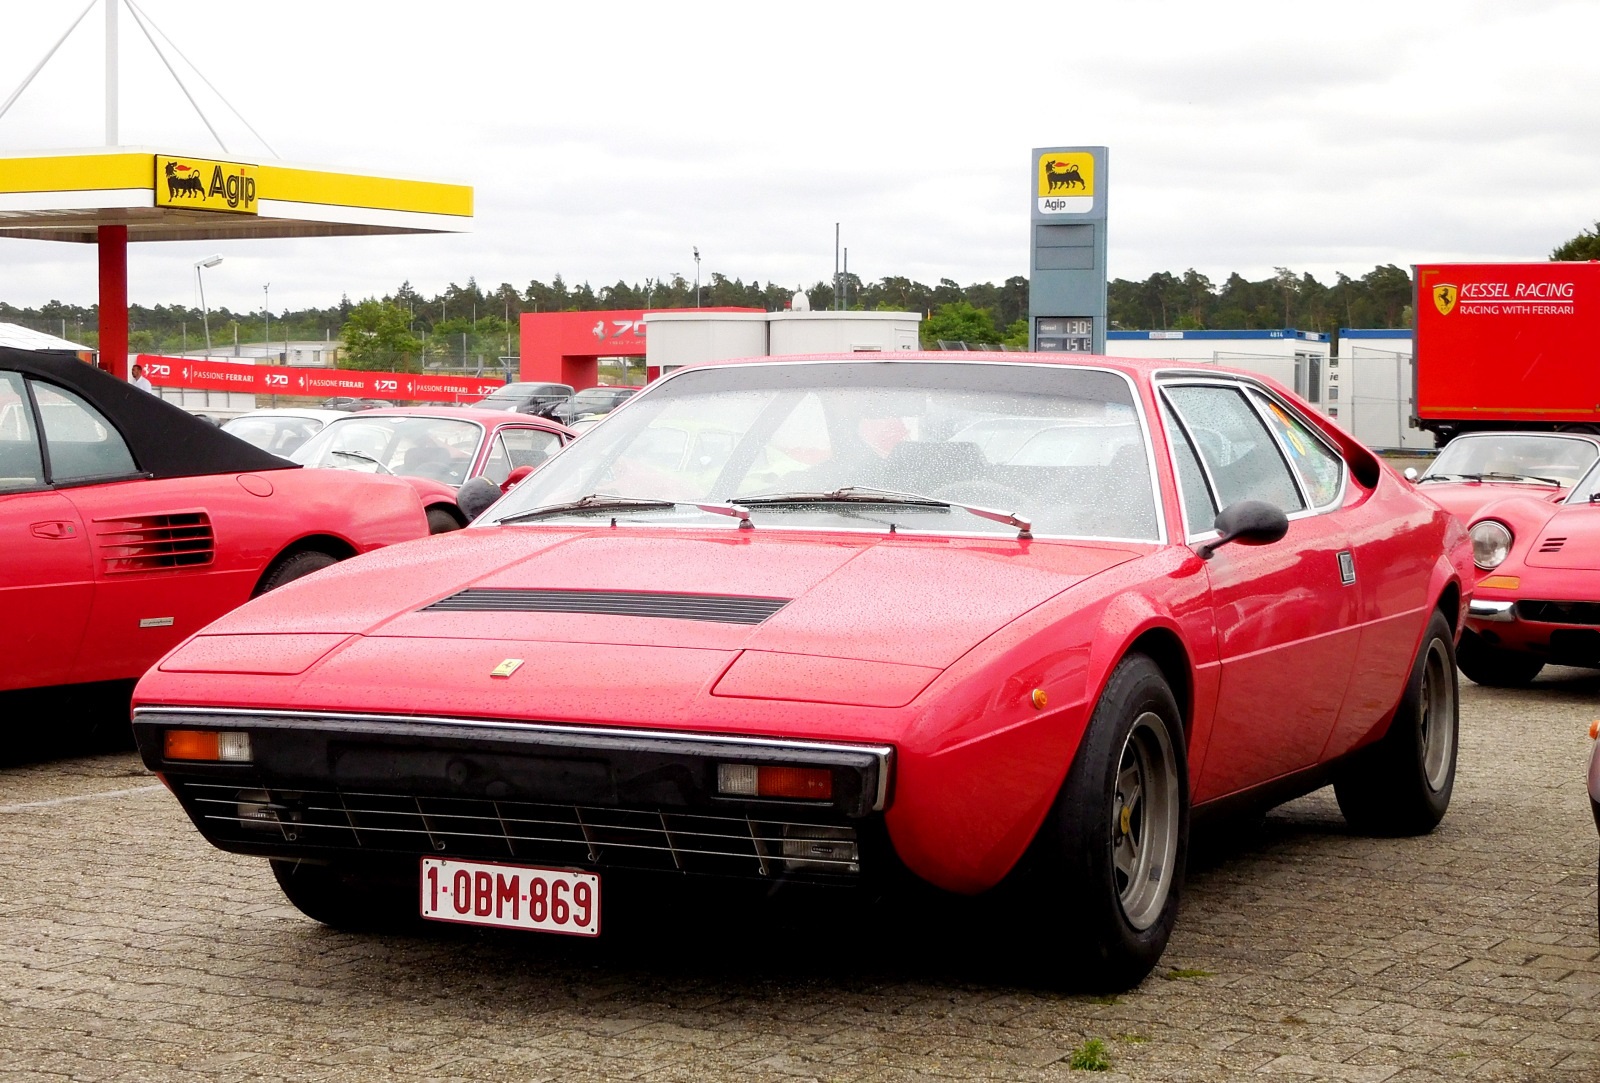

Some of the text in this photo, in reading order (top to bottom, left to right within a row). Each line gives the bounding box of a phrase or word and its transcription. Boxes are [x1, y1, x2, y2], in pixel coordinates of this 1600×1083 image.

[208, 165, 256, 209] Agip
[1044, 198, 1066, 211] Agip
[1460, 283, 1575, 298] KESSEL RACING
[1460, 305, 1499, 315] RACING
[1502, 305, 1531, 315] WITH
[1532, 305, 1574, 315] FERRARI
[151, 364, 170, 375] 70
[193, 370, 254, 382] PASSIONE FERRARI
[271, 374, 289, 385] 70
[309, 379, 364, 389] PASSIONE FERRARI
[379, 380, 398, 389] 70
[416, 384, 468, 393] PASSIONE FERRARI
